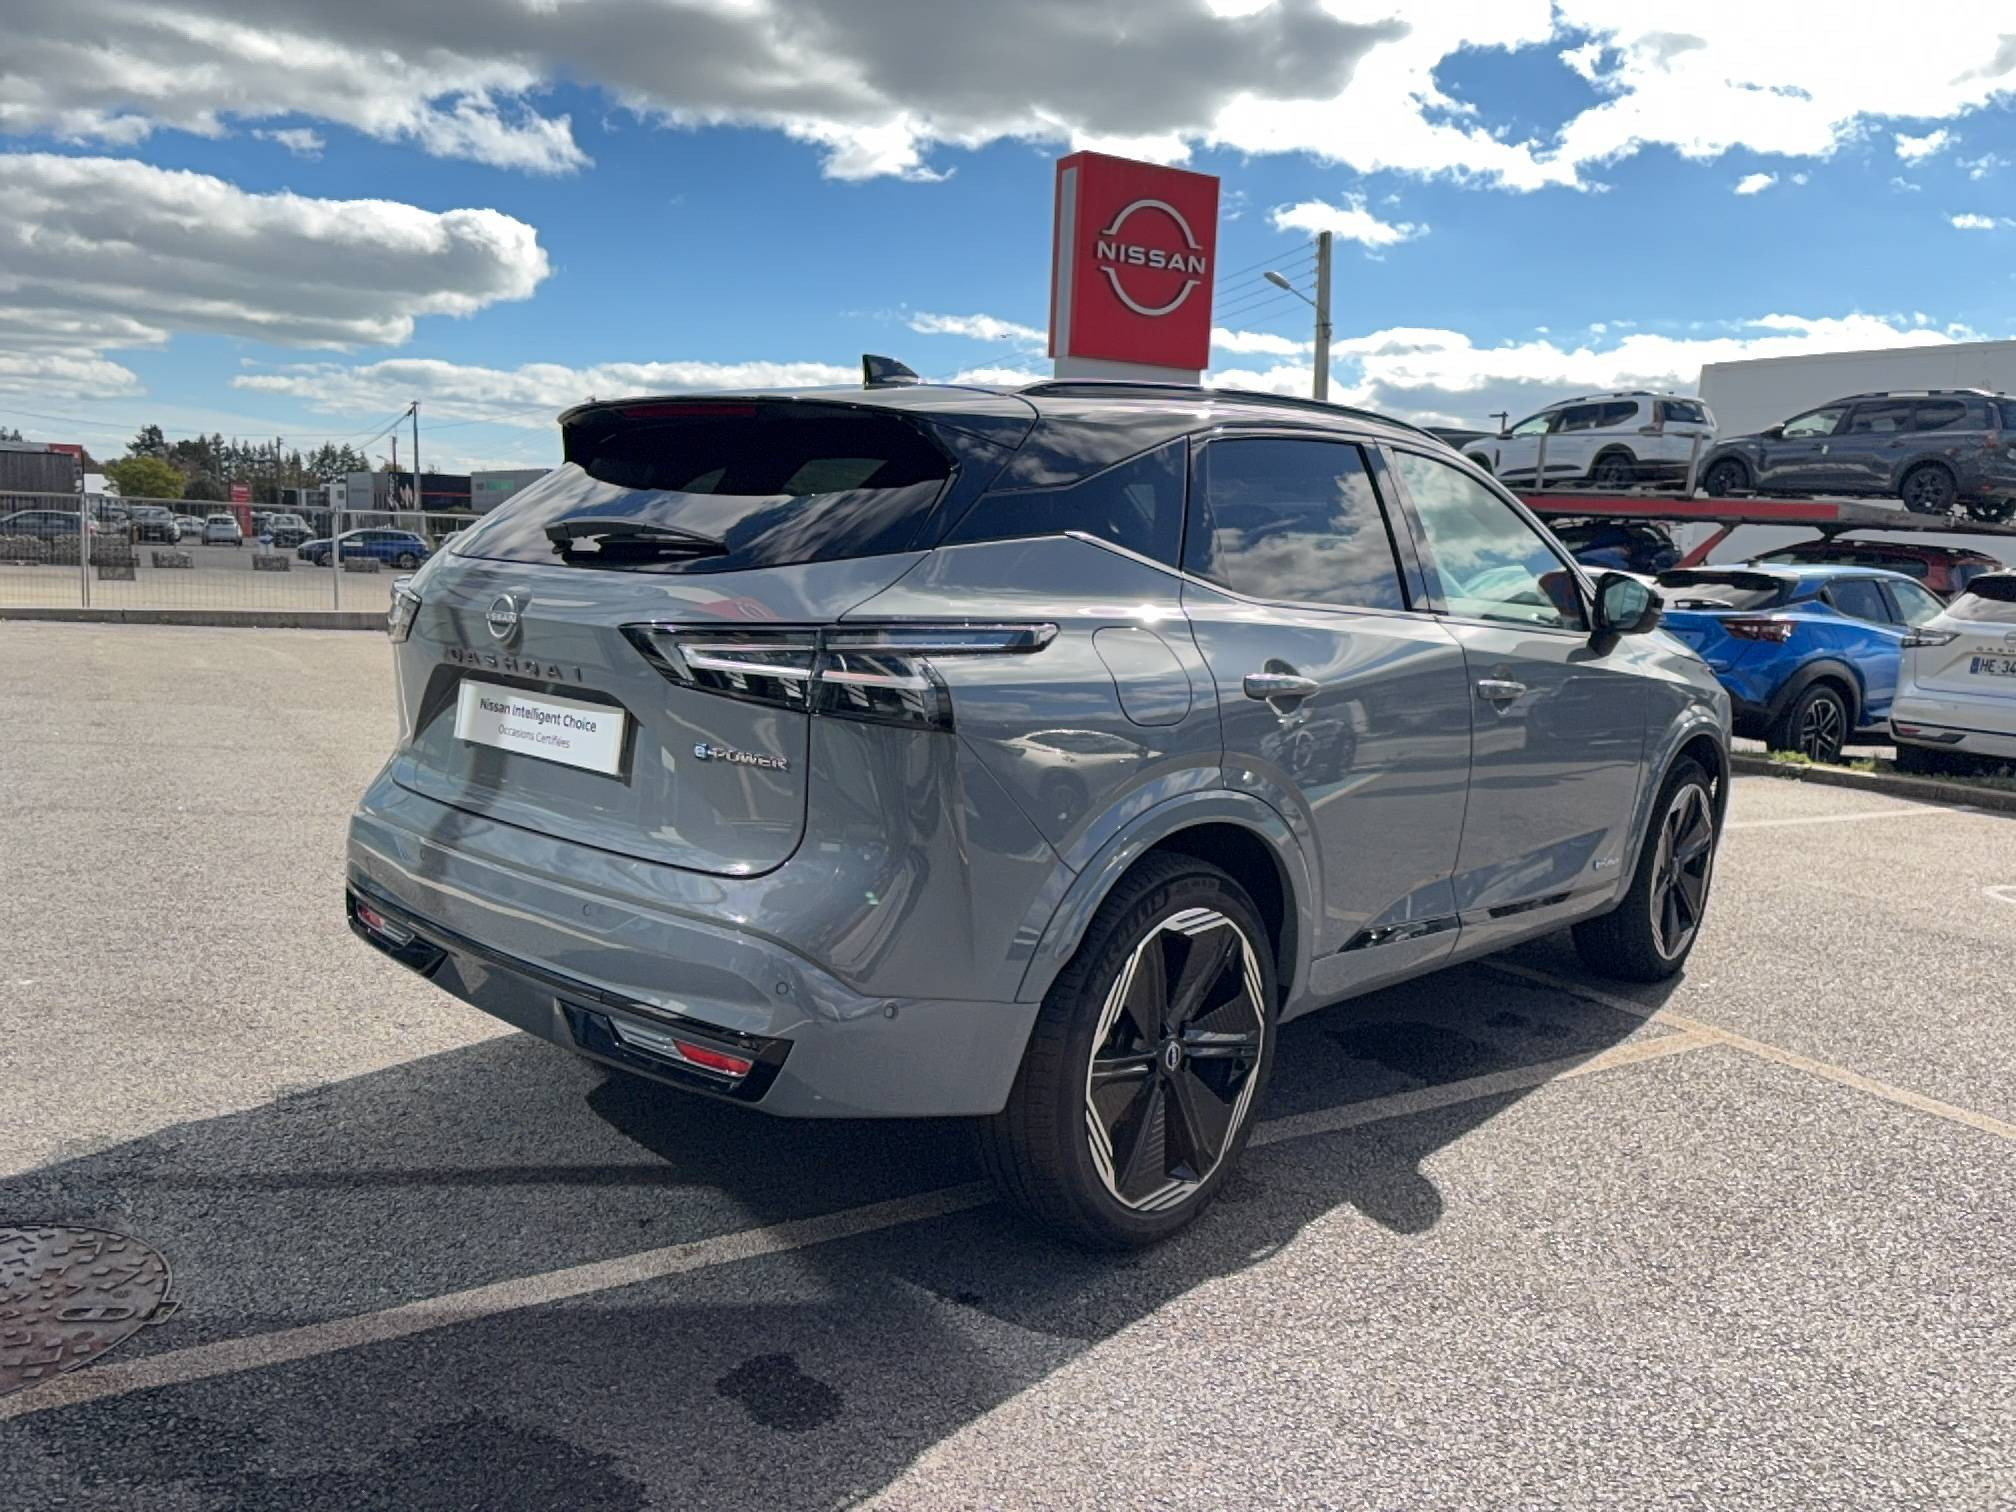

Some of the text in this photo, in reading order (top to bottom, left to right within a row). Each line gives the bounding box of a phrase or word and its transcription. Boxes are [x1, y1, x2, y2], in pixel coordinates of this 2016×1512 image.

[1097, 240, 1206, 275] NISSAN
[480, 697, 597, 733] Nissan Intelligent Choice
[498, 723, 535, 741] Occasions
